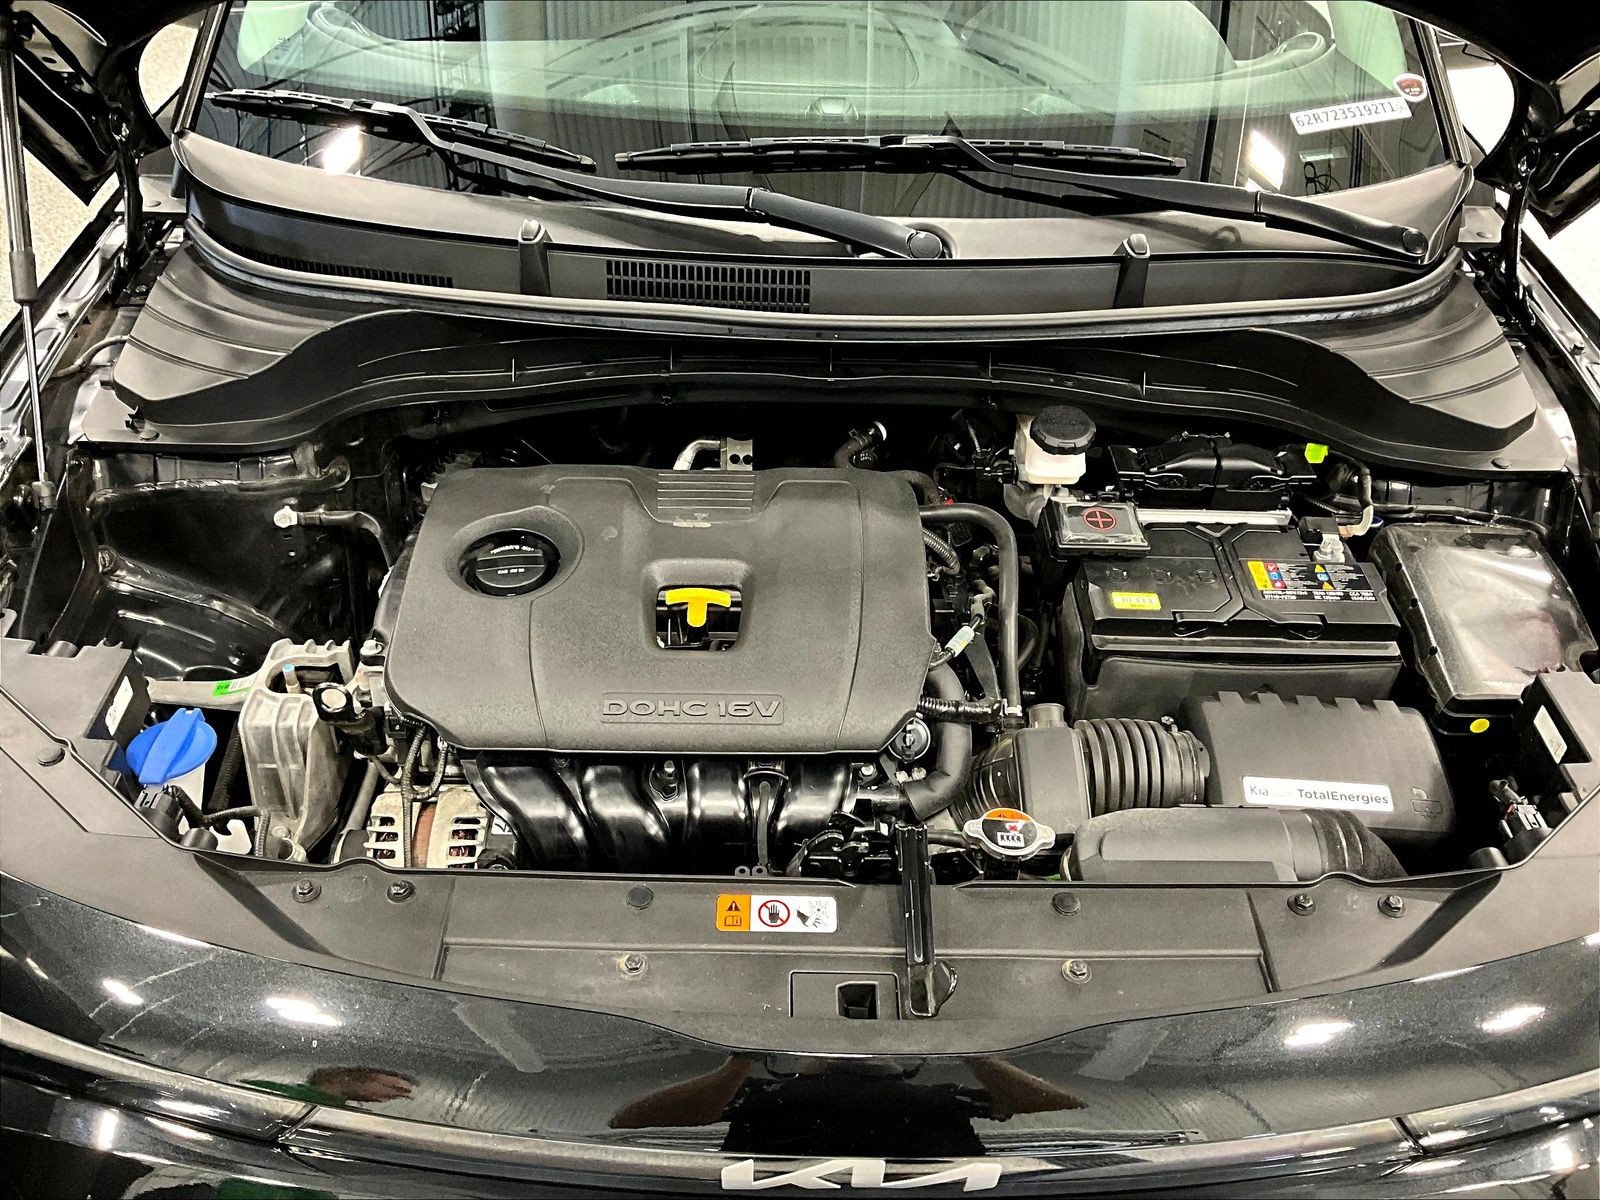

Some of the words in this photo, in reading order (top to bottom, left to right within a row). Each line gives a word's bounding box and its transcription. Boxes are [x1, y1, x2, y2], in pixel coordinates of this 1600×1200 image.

[602, 700, 708, 716] DOHC
[717, 700, 781, 718] 16V
[1250, 785, 1269, 796] Kia
[1297, 788, 1389, 805] TotalEnergies
